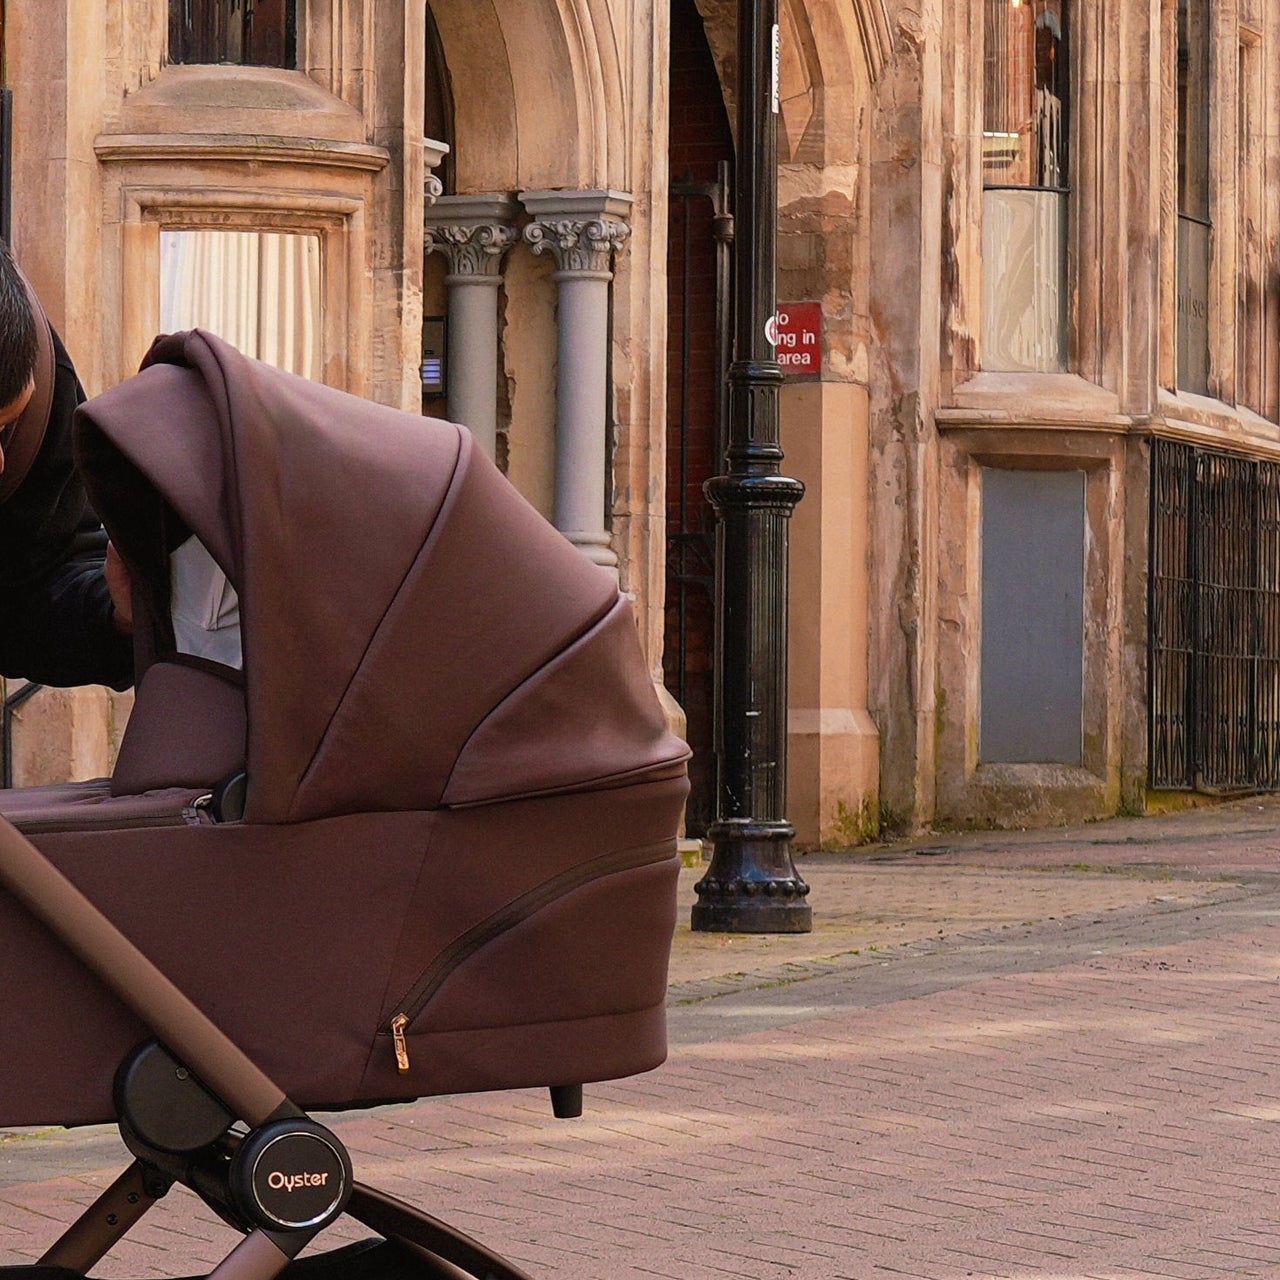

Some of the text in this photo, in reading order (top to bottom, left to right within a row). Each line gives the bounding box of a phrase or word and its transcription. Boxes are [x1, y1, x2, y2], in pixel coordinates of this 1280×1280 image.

[802, 329, 816, 345] in
[777, 352, 811, 365] area
[268, 1171, 329, 1193] Oyster
